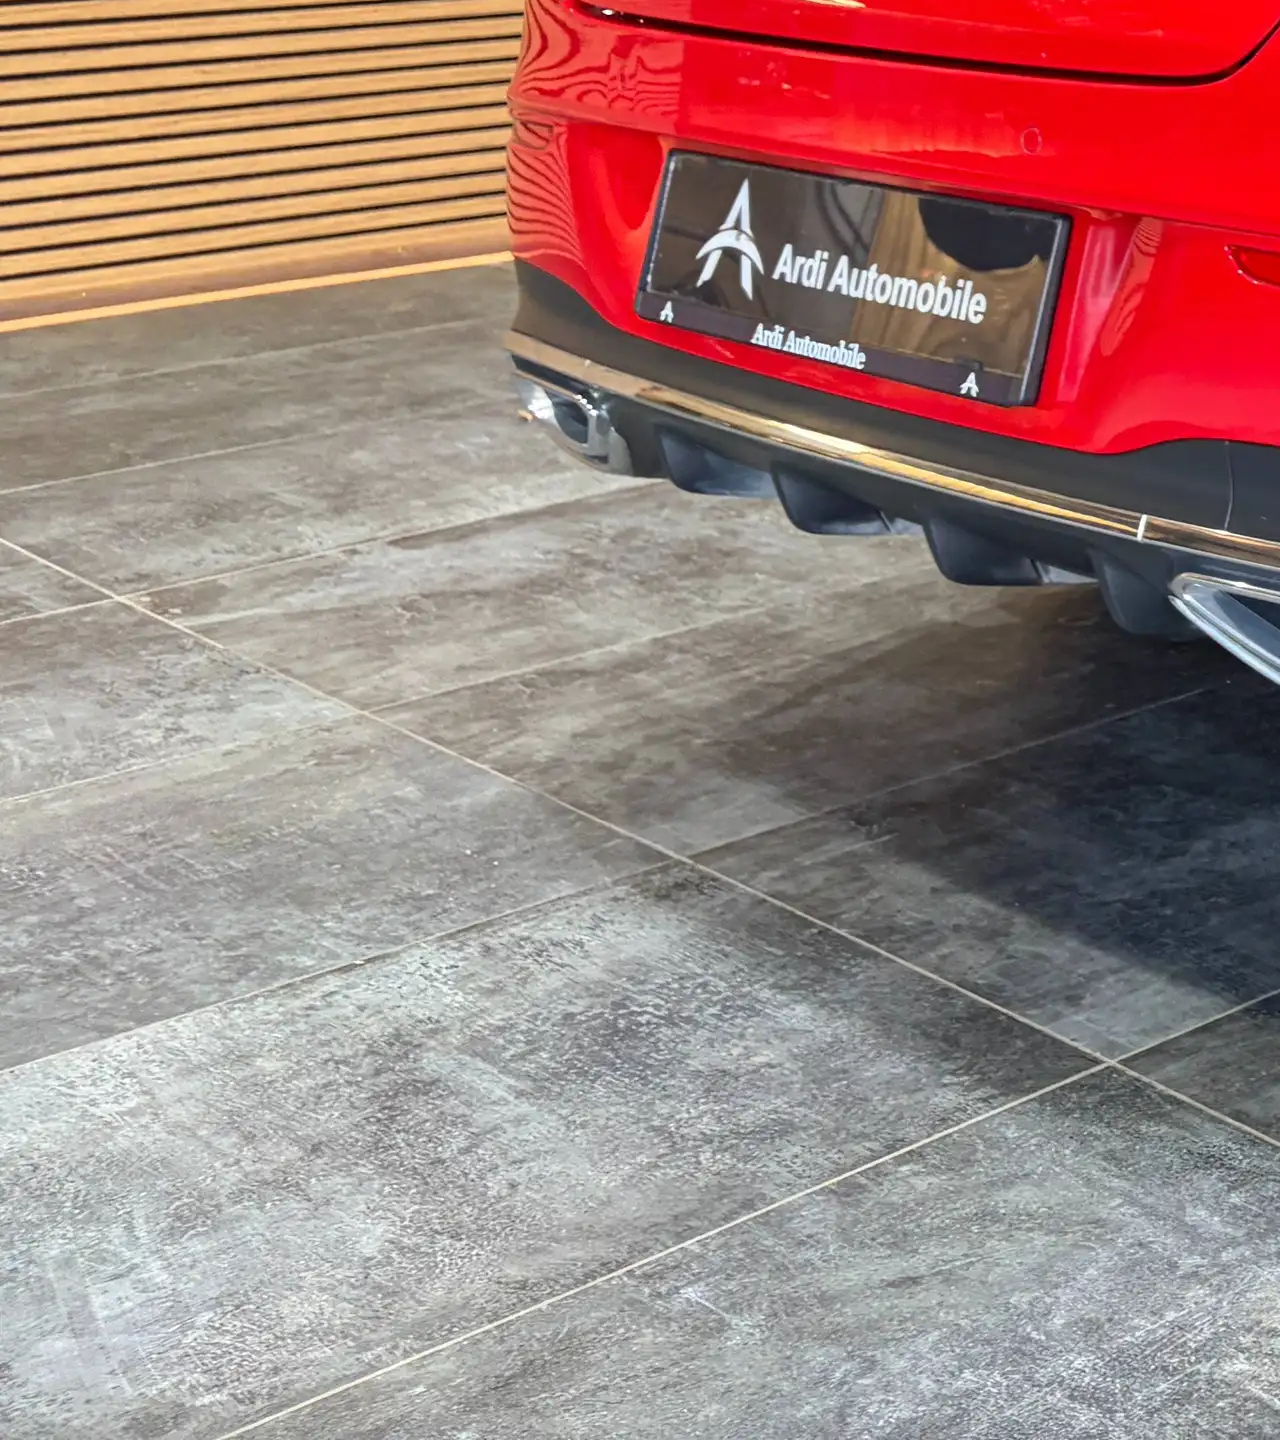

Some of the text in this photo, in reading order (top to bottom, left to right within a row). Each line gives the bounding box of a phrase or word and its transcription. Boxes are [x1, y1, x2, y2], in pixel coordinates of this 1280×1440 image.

[771, 242, 988, 325] Ardi Automobile
[750, 322, 867, 371] Ardi Automobile
